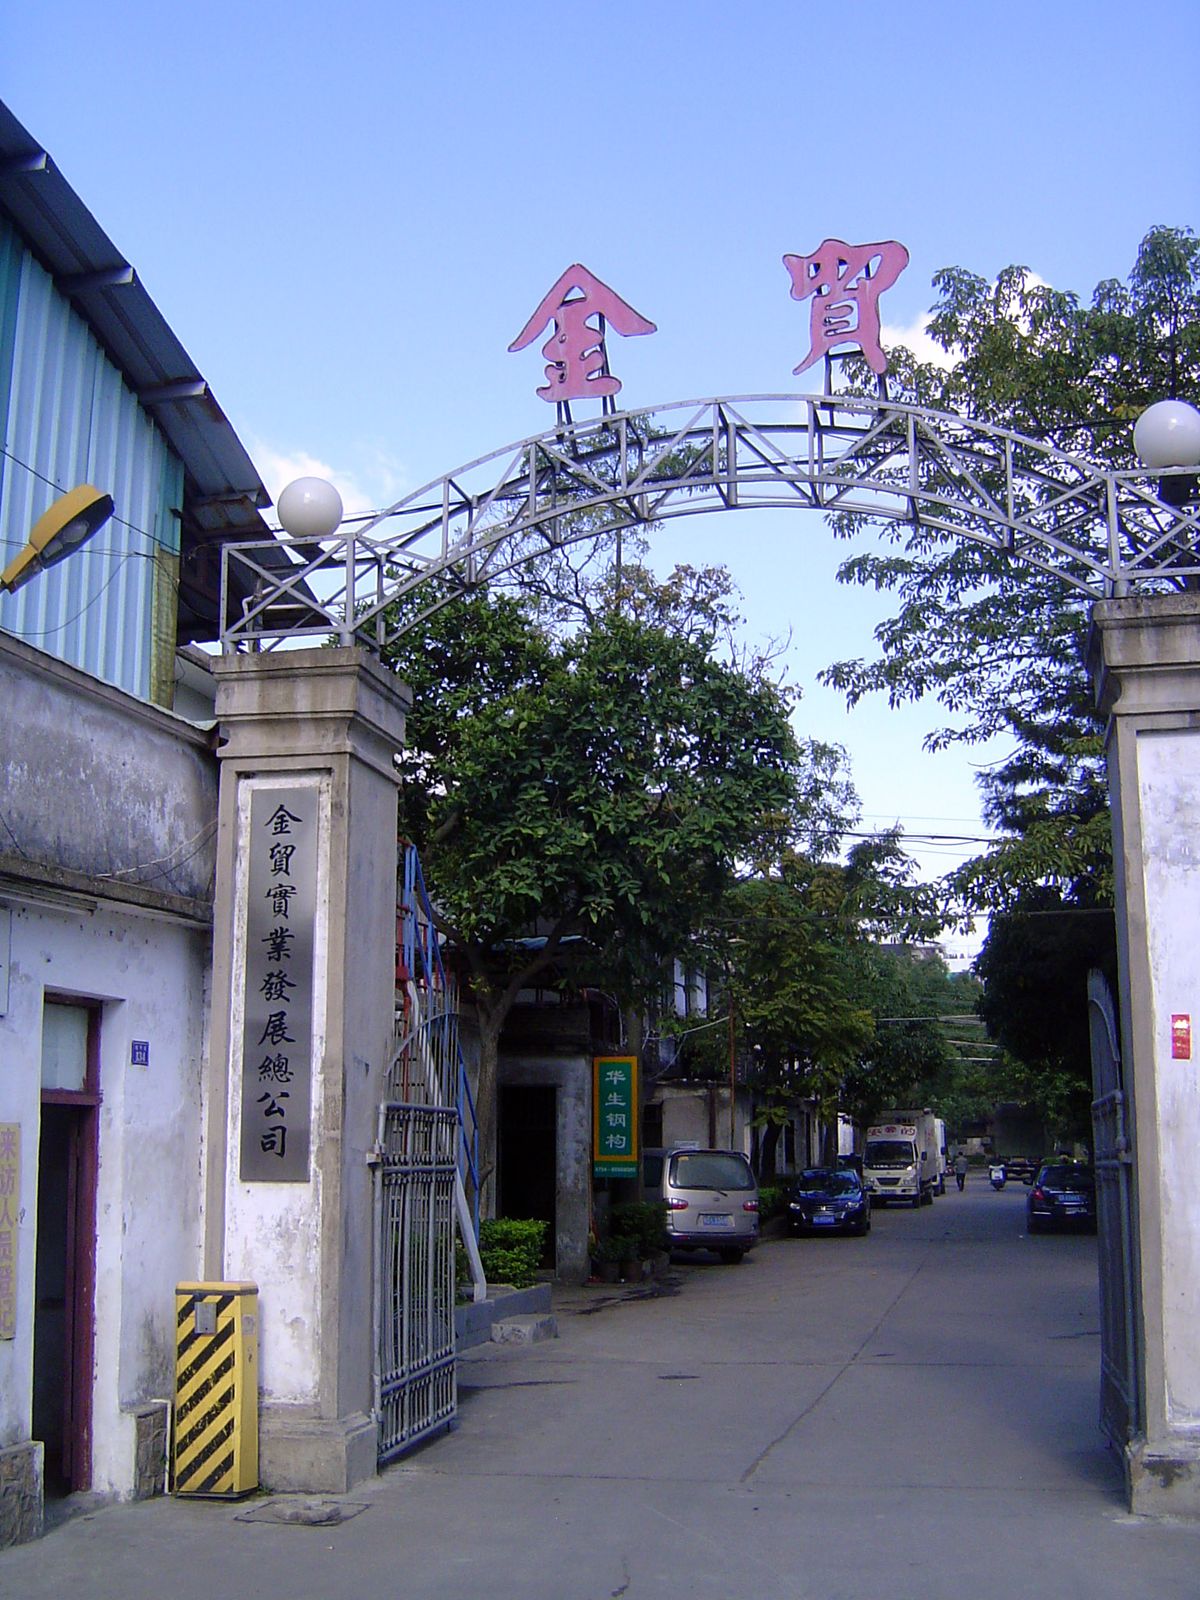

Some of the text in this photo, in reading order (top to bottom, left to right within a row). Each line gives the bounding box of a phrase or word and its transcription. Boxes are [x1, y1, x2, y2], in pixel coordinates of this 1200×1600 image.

[257, 804, 303, 1159] 金貿實業發展總公司
[604, 1069, 627, 1152] 华生钢构
